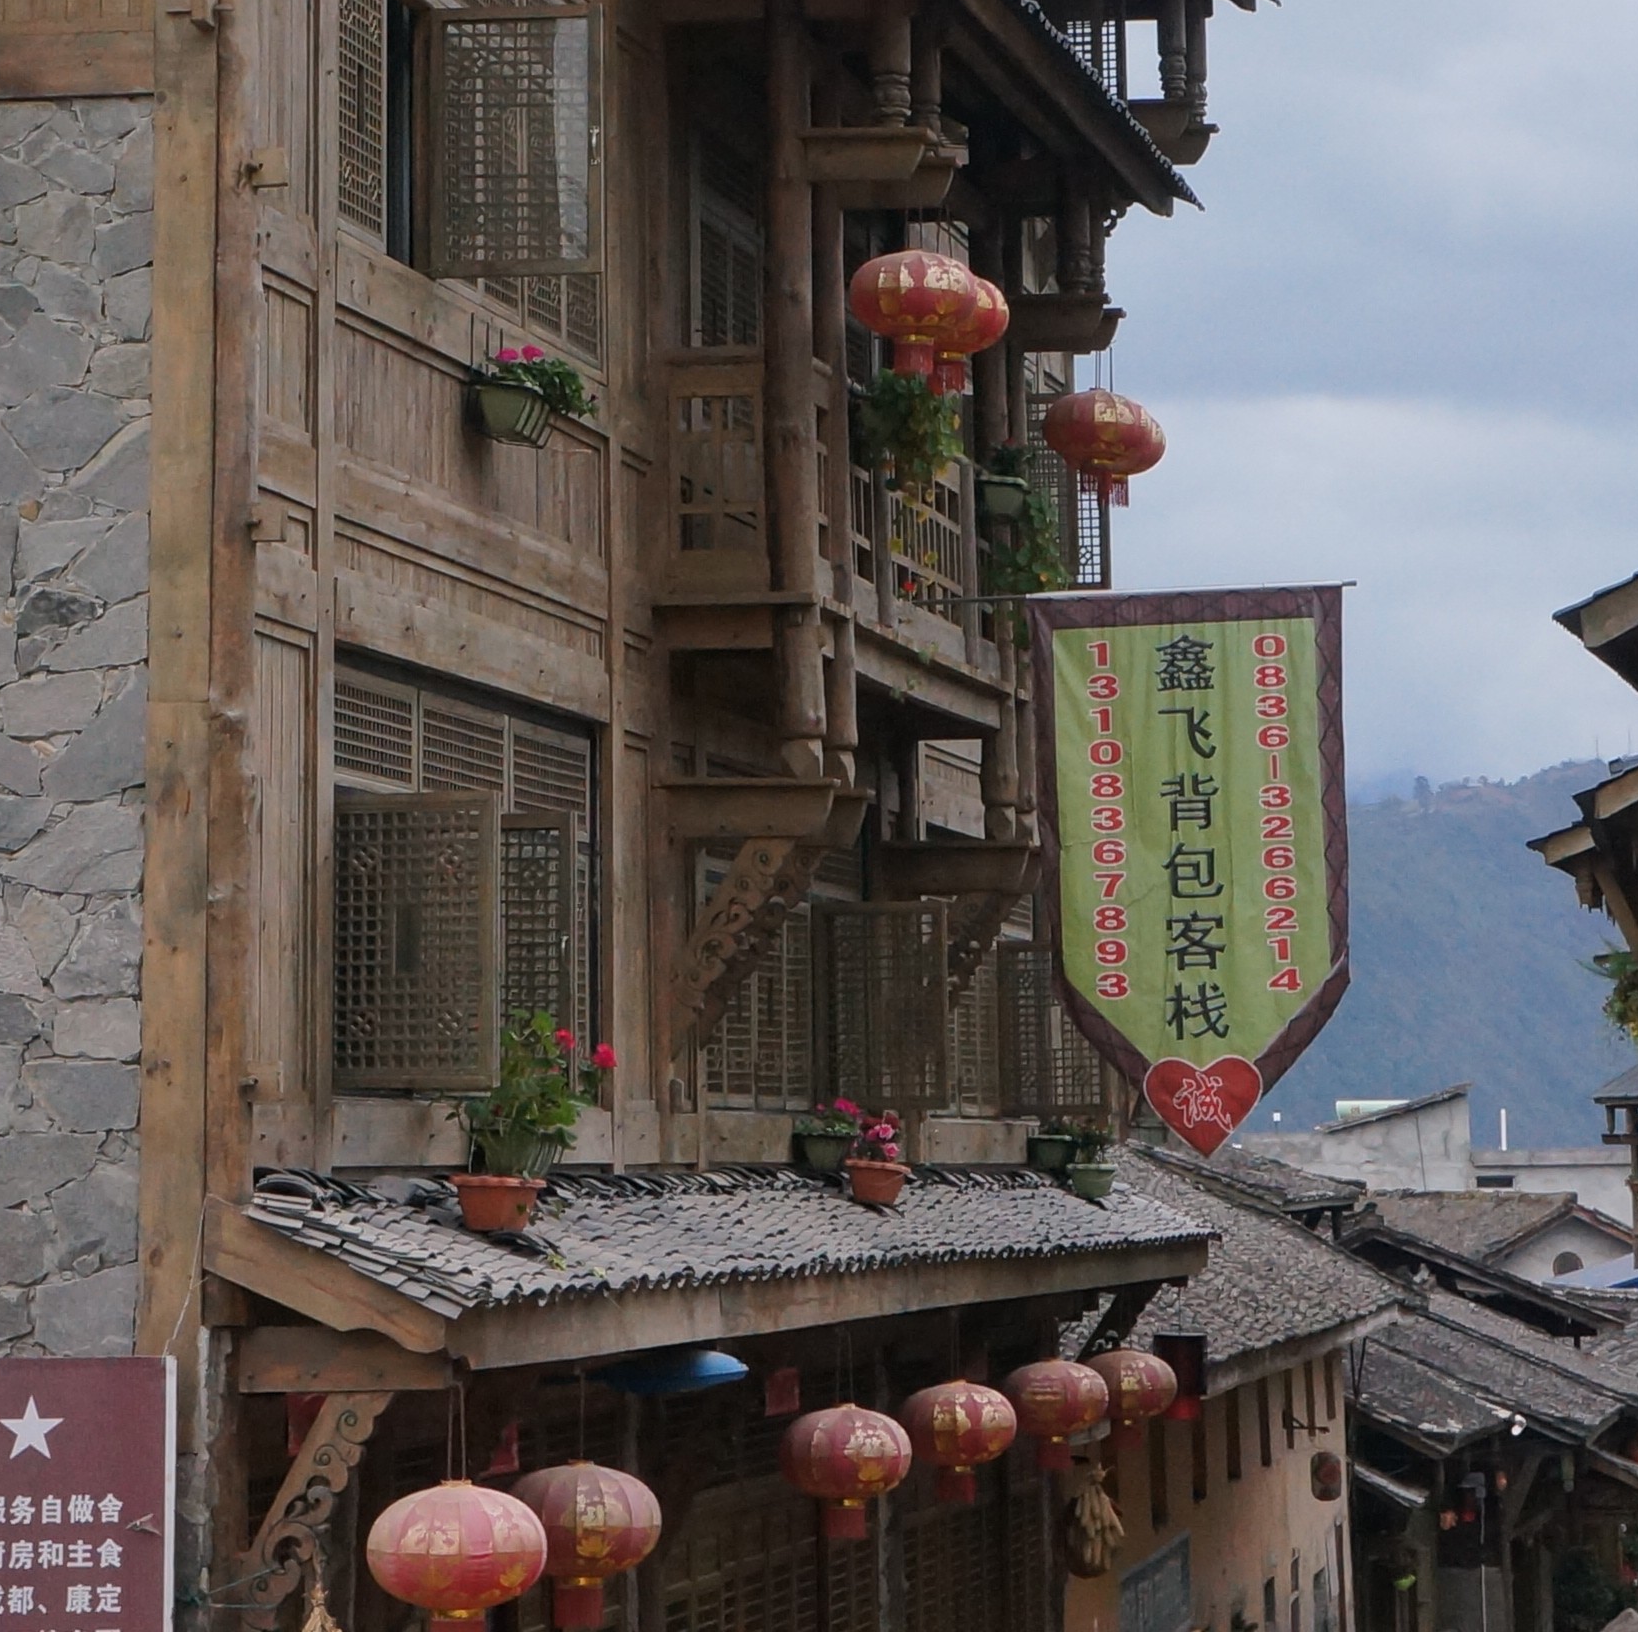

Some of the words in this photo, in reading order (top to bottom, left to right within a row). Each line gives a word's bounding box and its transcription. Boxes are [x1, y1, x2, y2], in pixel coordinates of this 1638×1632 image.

[1086, 639, 1130, 1000] 13108367893
[1154, 634, 1230, 1042] 鑫飞背包客栈
